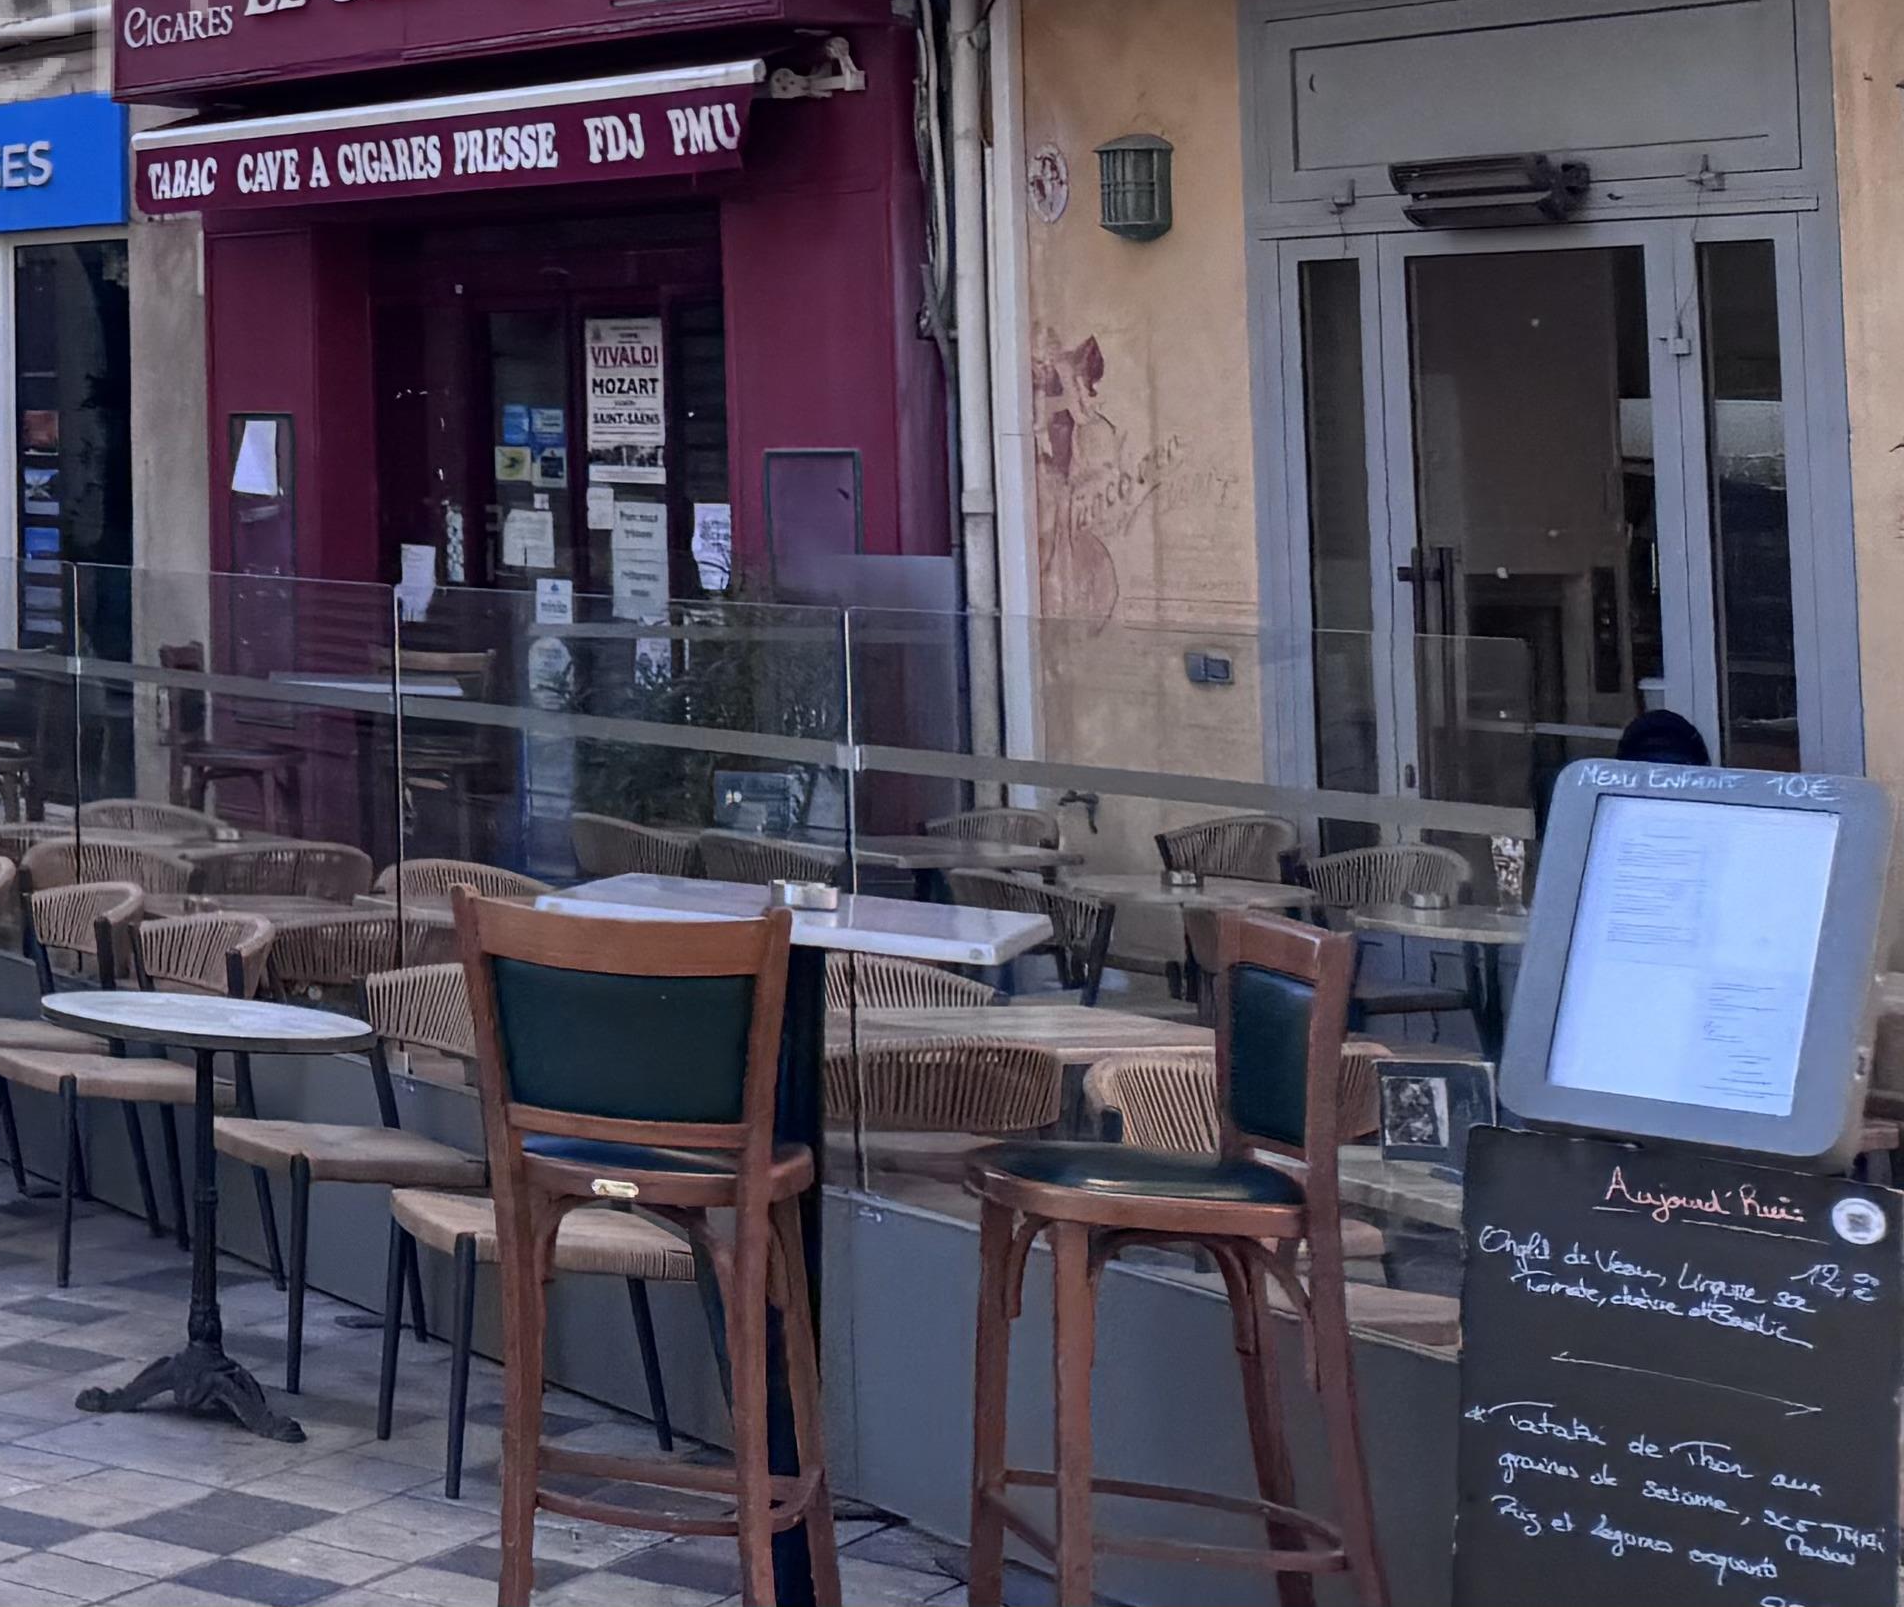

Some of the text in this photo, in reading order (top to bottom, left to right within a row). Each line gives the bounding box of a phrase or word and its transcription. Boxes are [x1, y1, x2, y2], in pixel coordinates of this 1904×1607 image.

[123, 2, 233, 49] CIGARES
[147, 101, 741, 202] TABAC CAVE A CIGARES PRESSE FDJ PMU
[591, 345, 658, 366] VIVALDI
[591, 377, 660, 395] MOZART
[1766, 775, 1841, 801] 10€
[1563, 1241, 1592, 1265] de
[1628, 1433, 1664, 1459] de
